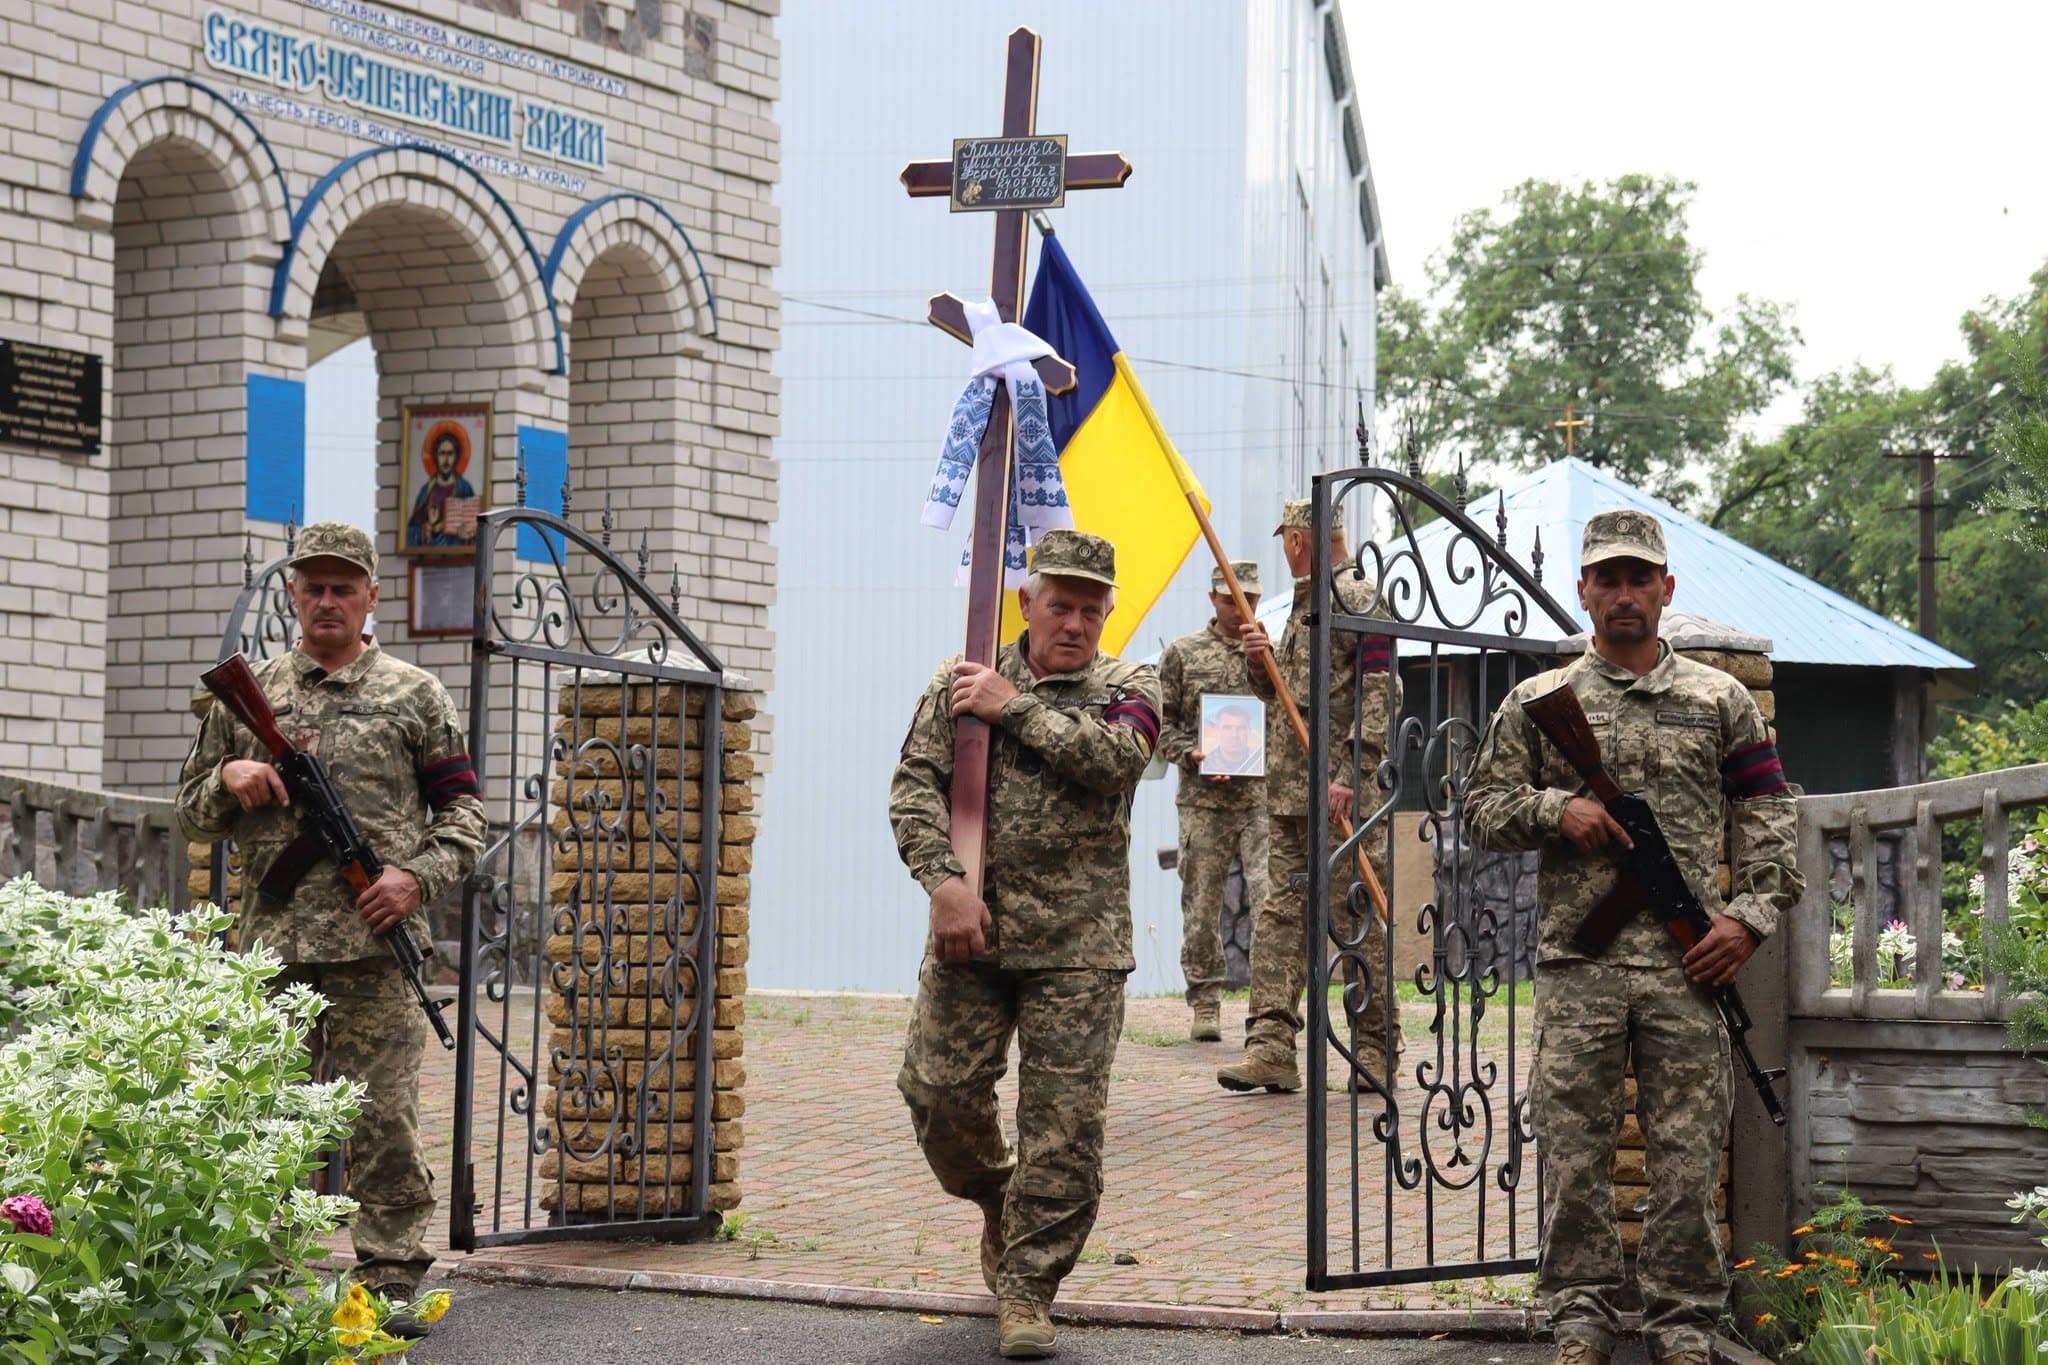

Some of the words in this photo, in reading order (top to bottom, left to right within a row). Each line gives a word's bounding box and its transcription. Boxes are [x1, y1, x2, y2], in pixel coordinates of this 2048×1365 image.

[230, 89, 249, 104] НА
[514, 163, 530, 178] ЗА
[527, 103, 604, 166] ХРАМ
